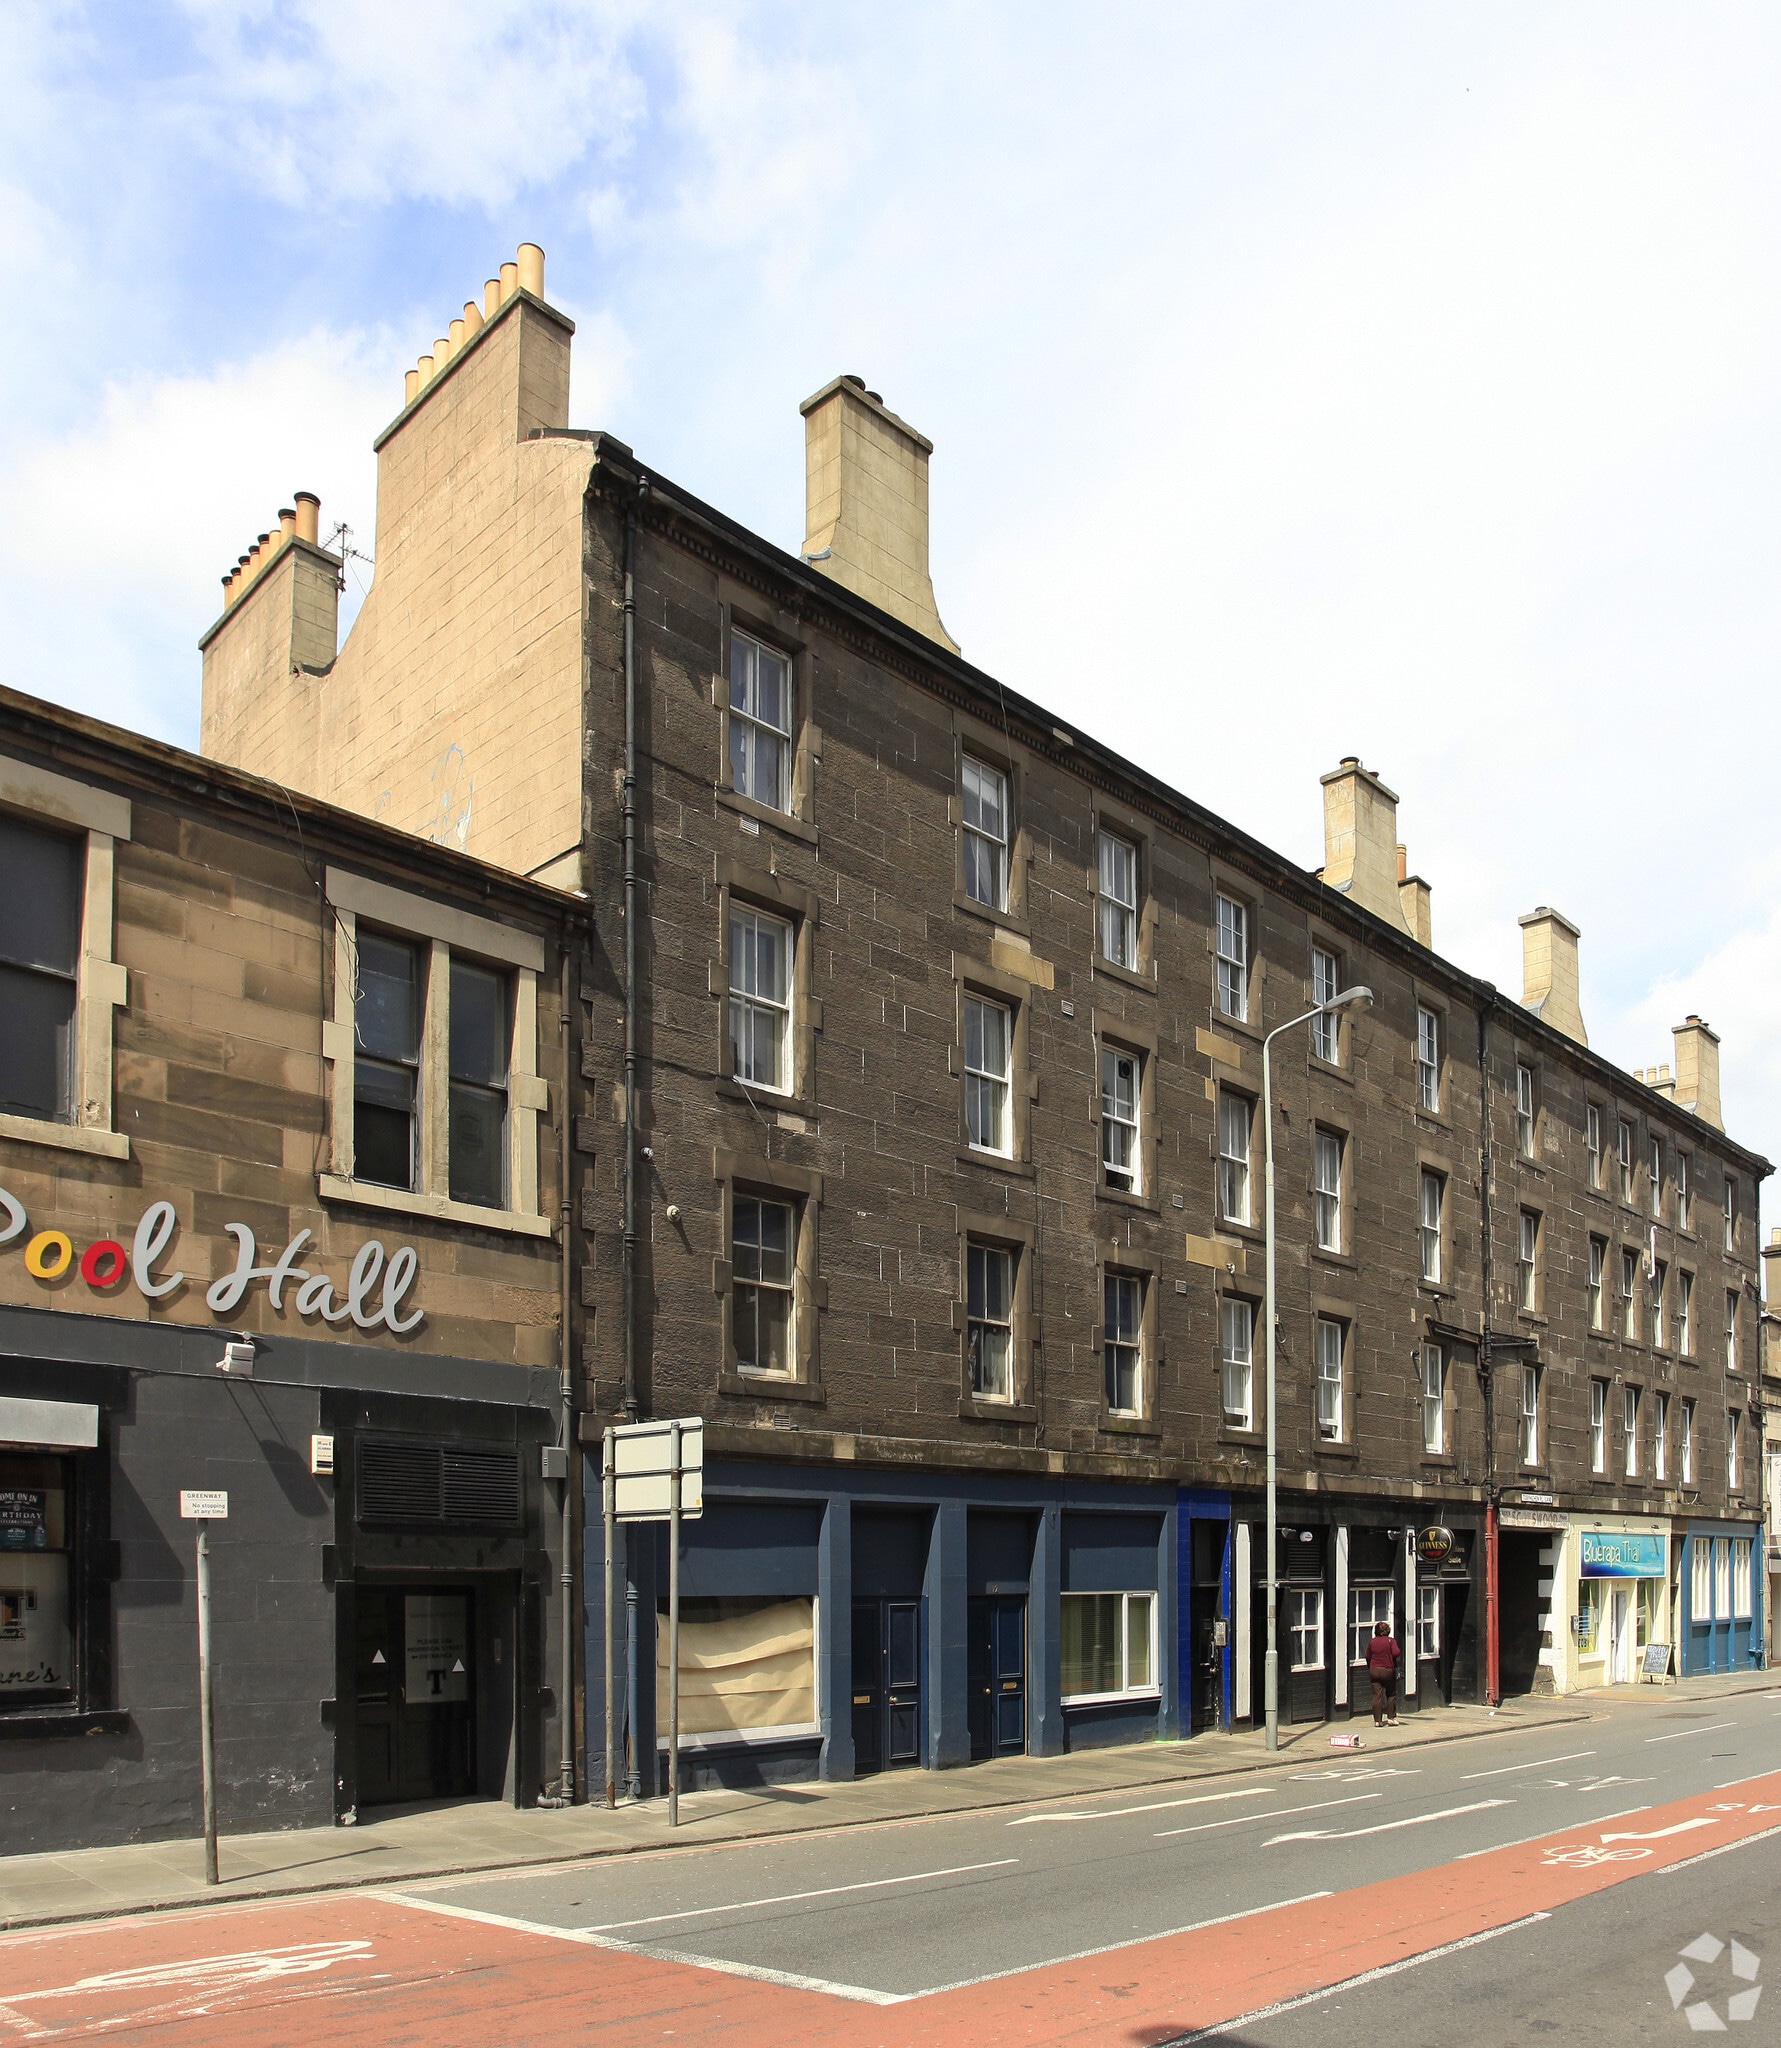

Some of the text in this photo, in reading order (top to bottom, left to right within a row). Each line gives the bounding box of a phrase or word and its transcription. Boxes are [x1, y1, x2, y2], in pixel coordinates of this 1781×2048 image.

[206, 1222, 424, 1333] Hall
[0, 1492, 15, 1501] OME
[0, 1511, 42, 1519] RTHDAY
[1418, 1541, 1448, 1550] GUINNESS
[1622, 1540, 1640, 1563] Thai
[426, 1669, 447, 1695] T
